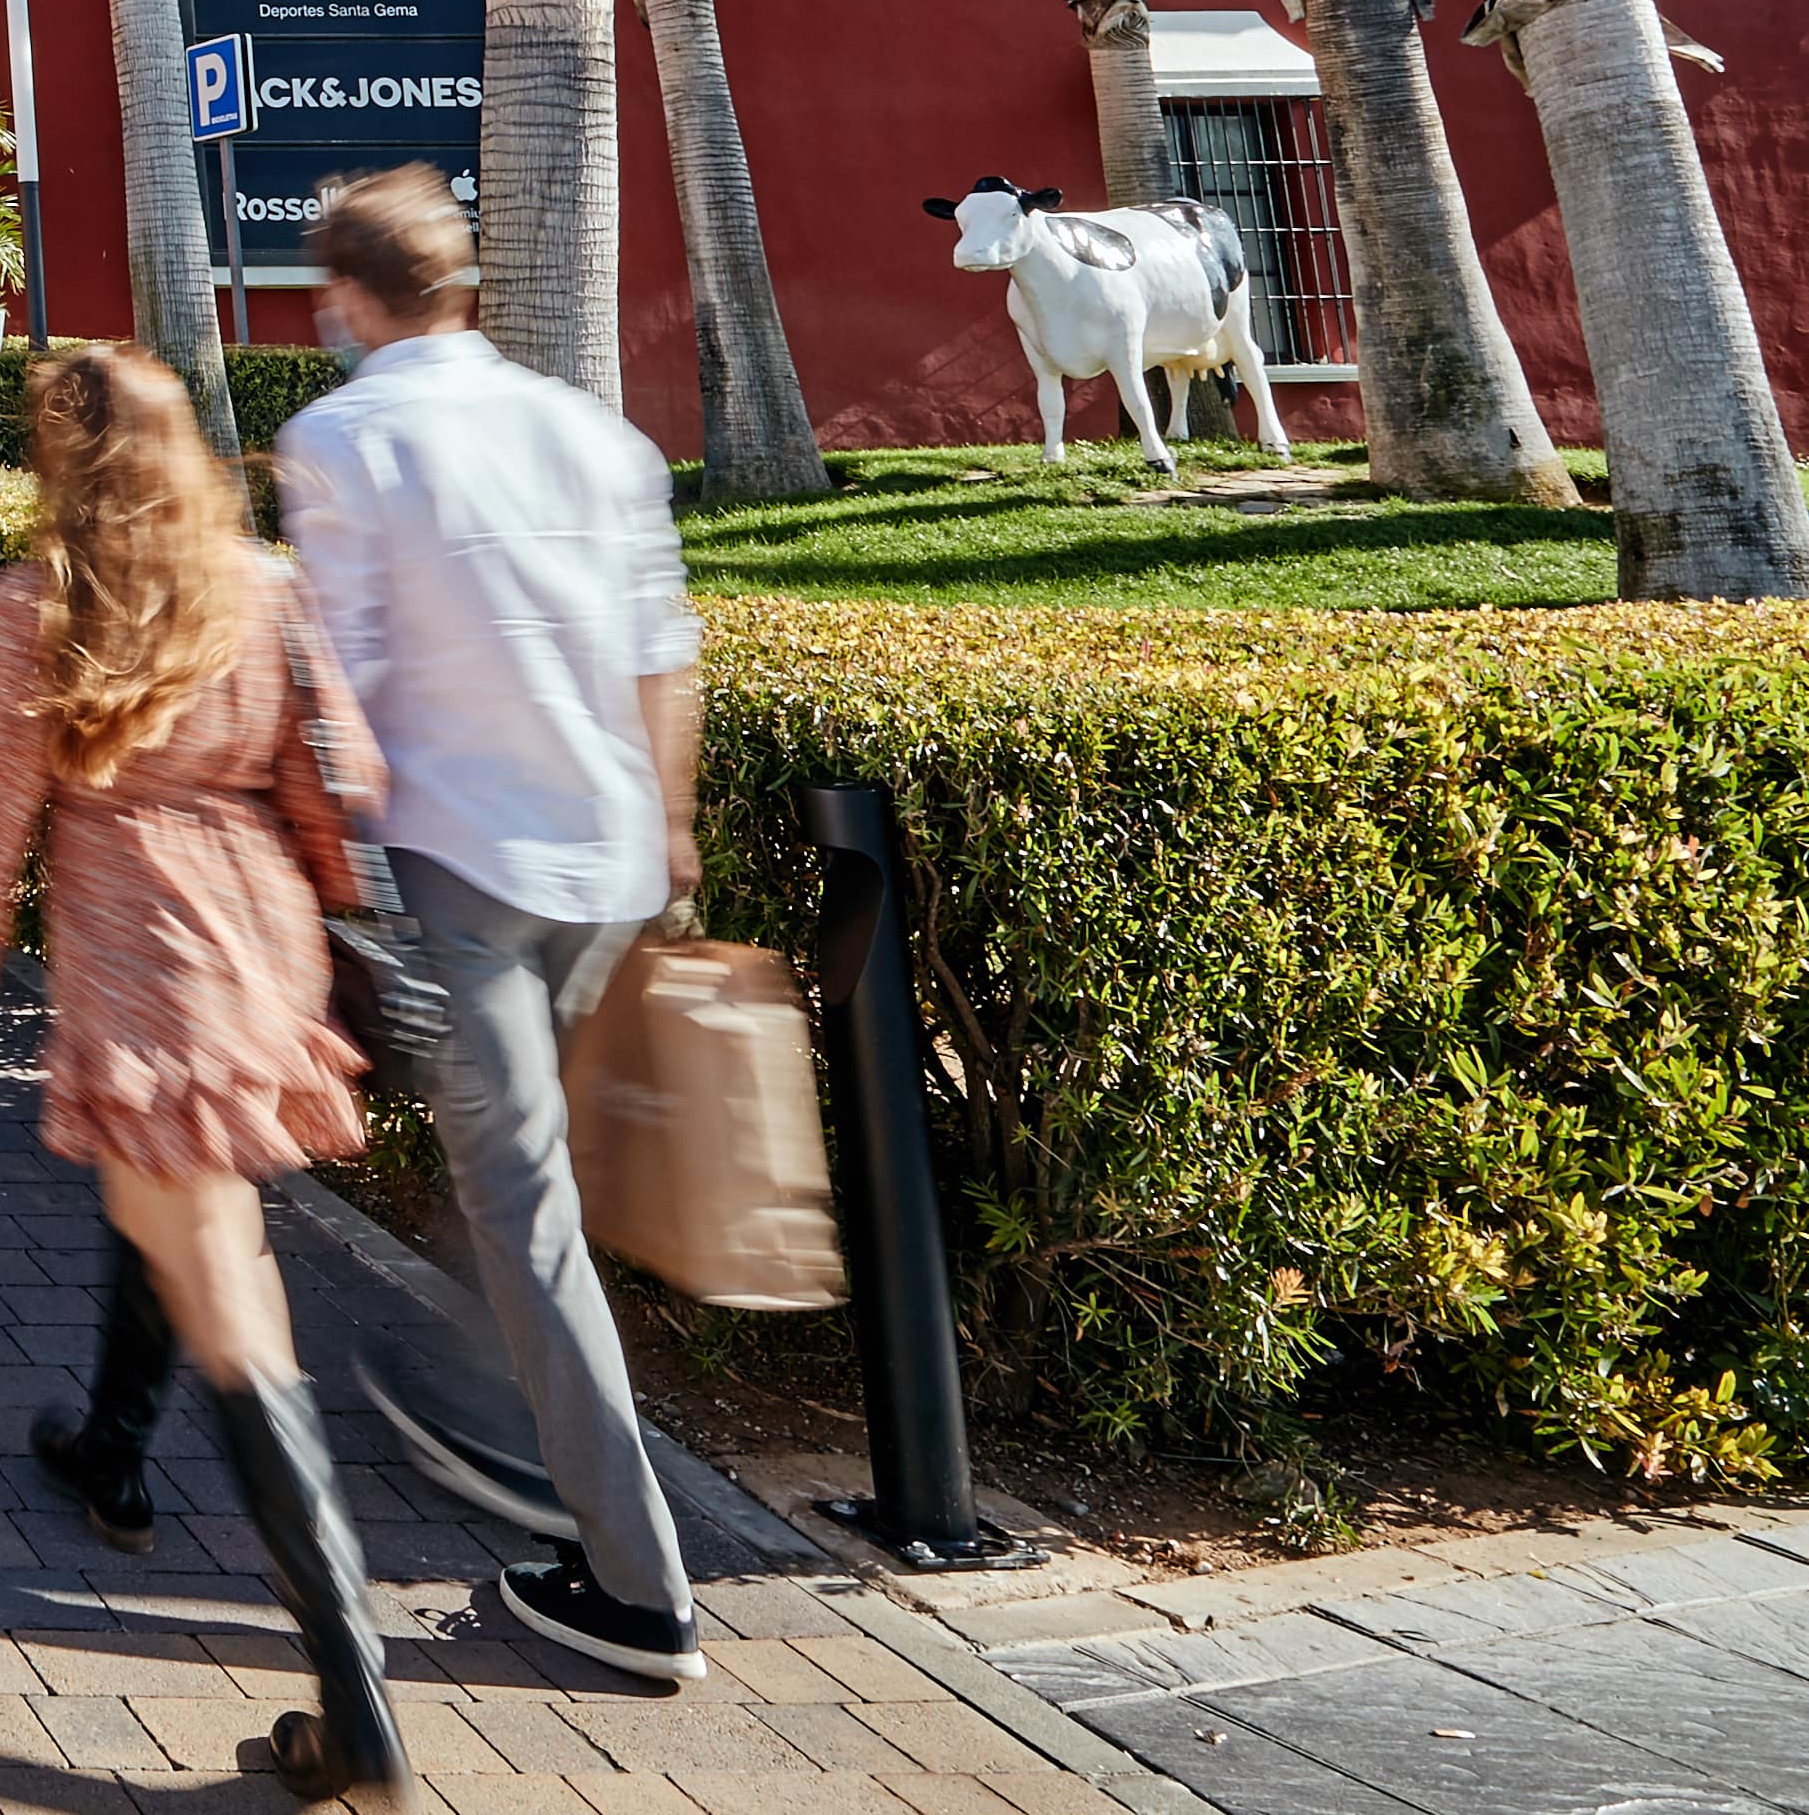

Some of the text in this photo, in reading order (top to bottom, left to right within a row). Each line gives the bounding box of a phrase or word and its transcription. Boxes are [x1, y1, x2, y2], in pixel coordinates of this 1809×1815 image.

[259, 3, 419, 19] Deportes Santa Gema
[194, 52, 228, 127] P
[254, 77, 483, 109] CK&JONES
